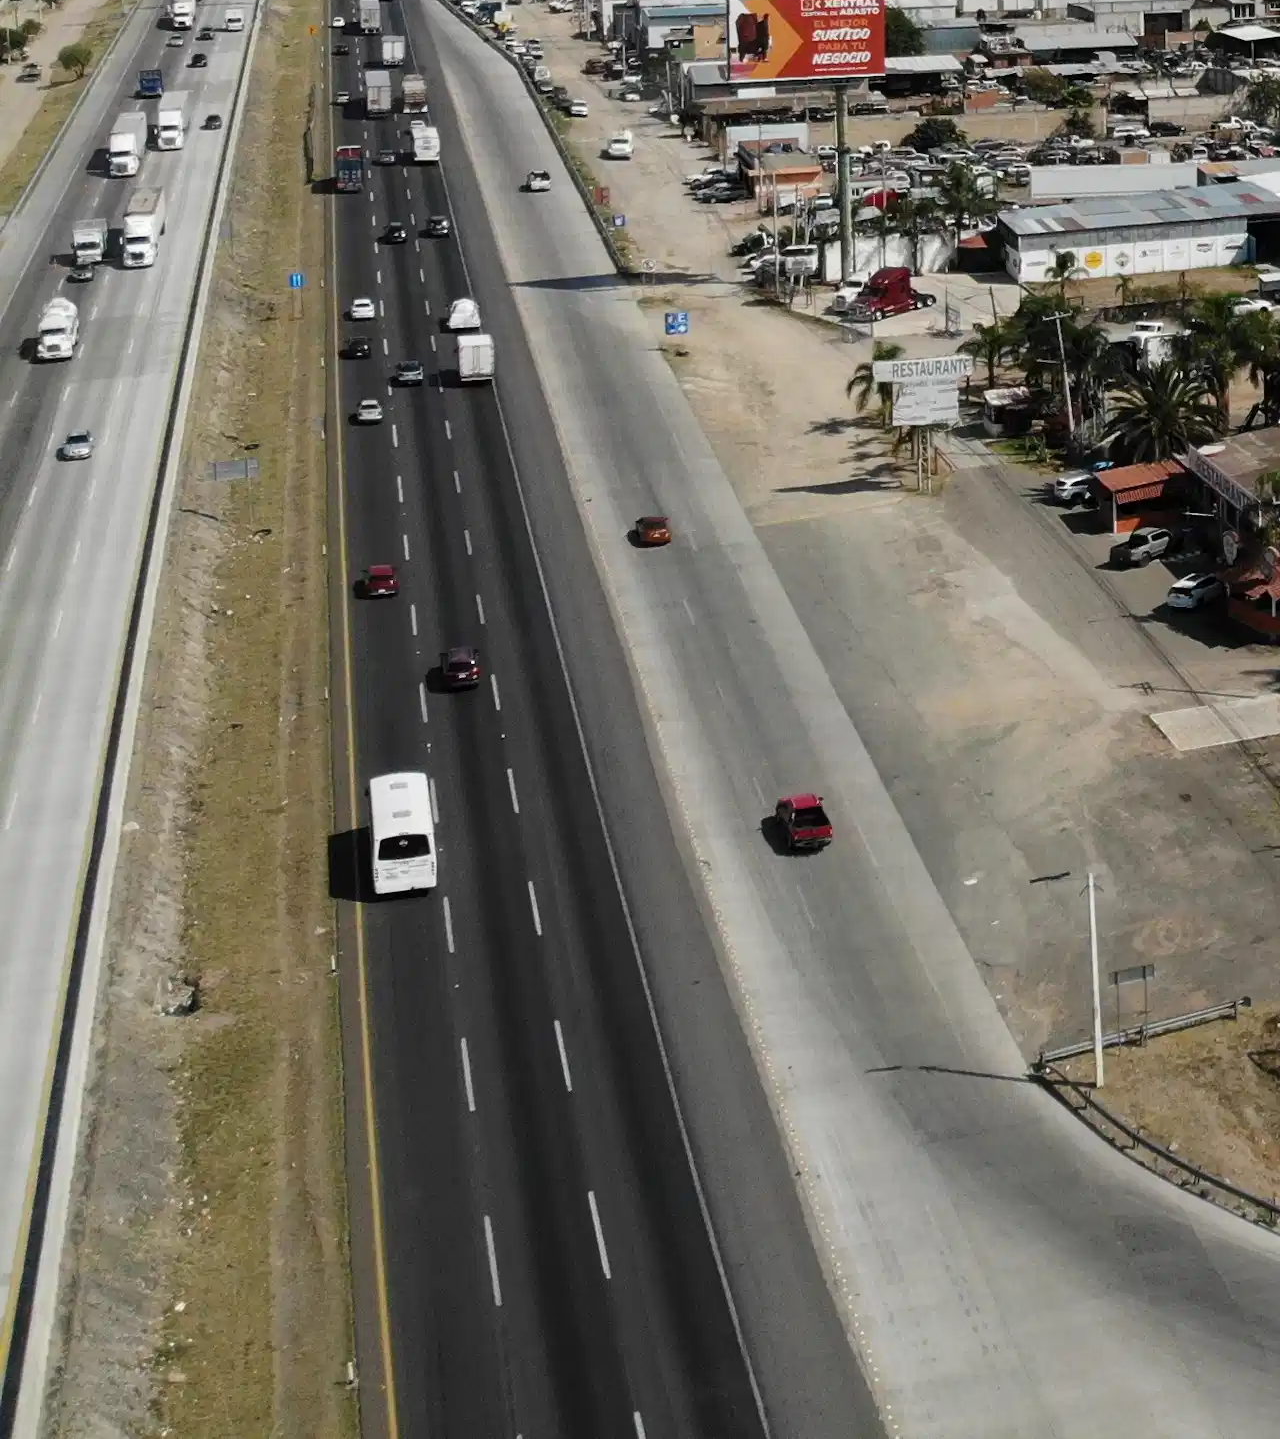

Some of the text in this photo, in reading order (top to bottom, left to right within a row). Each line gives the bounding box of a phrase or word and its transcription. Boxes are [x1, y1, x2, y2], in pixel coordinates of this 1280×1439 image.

[839, 7, 880, 15] ABASTO
[813, 18, 868, 28] EL MEJOR
[812, 28, 870, 41] SURTIDO
[818, 42, 866, 52] PARA TU
[812, 51, 871, 65] NEGOCIO
